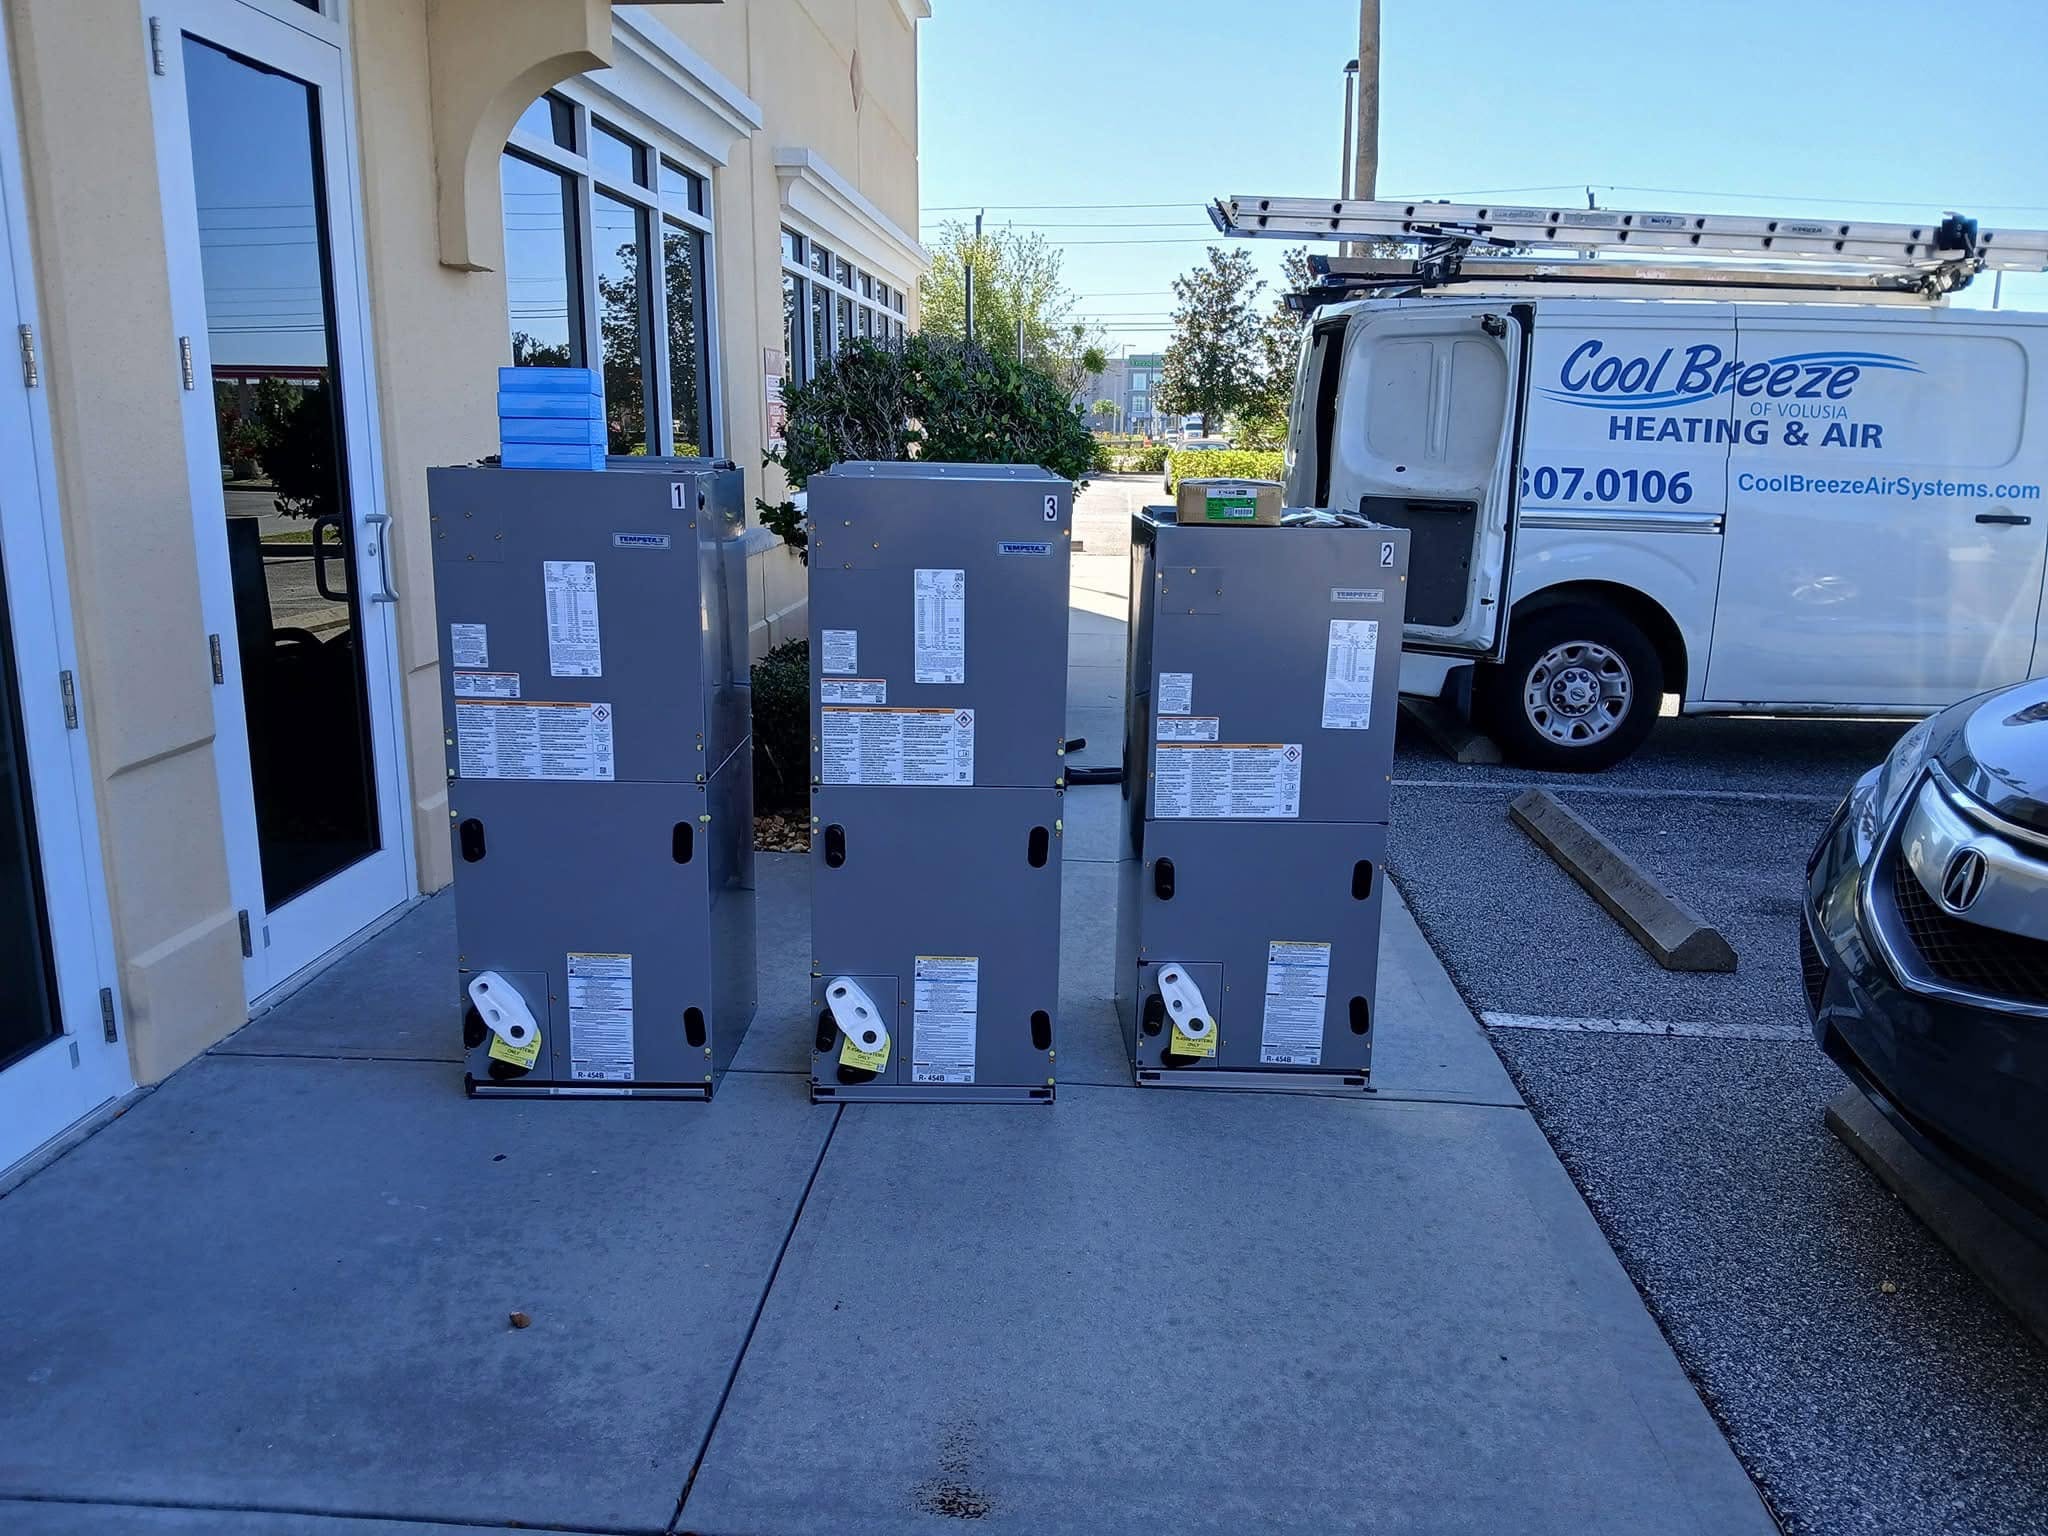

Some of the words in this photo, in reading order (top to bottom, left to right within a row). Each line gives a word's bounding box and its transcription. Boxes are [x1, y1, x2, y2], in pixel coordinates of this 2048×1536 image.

[1560, 339, 1674, 394] Cool
[1675, 344, 1860, 399] Breeze
[1750, 402, 1773, 416] OF
[1777, 403, 1848, 420] VOLUSIA
[1608, 415, 1769, 445] HEATING
[1783, 421, 1809, 446] &
[1820, 423, 1883, 449] AIR
[674, 484, 682, 507] 1
[1738, 473, 2041, 500] CoolBreezeAirSystems.com
[1046, 497, 1056, 519] 3
[1382, 544, 1393, 566] 2
